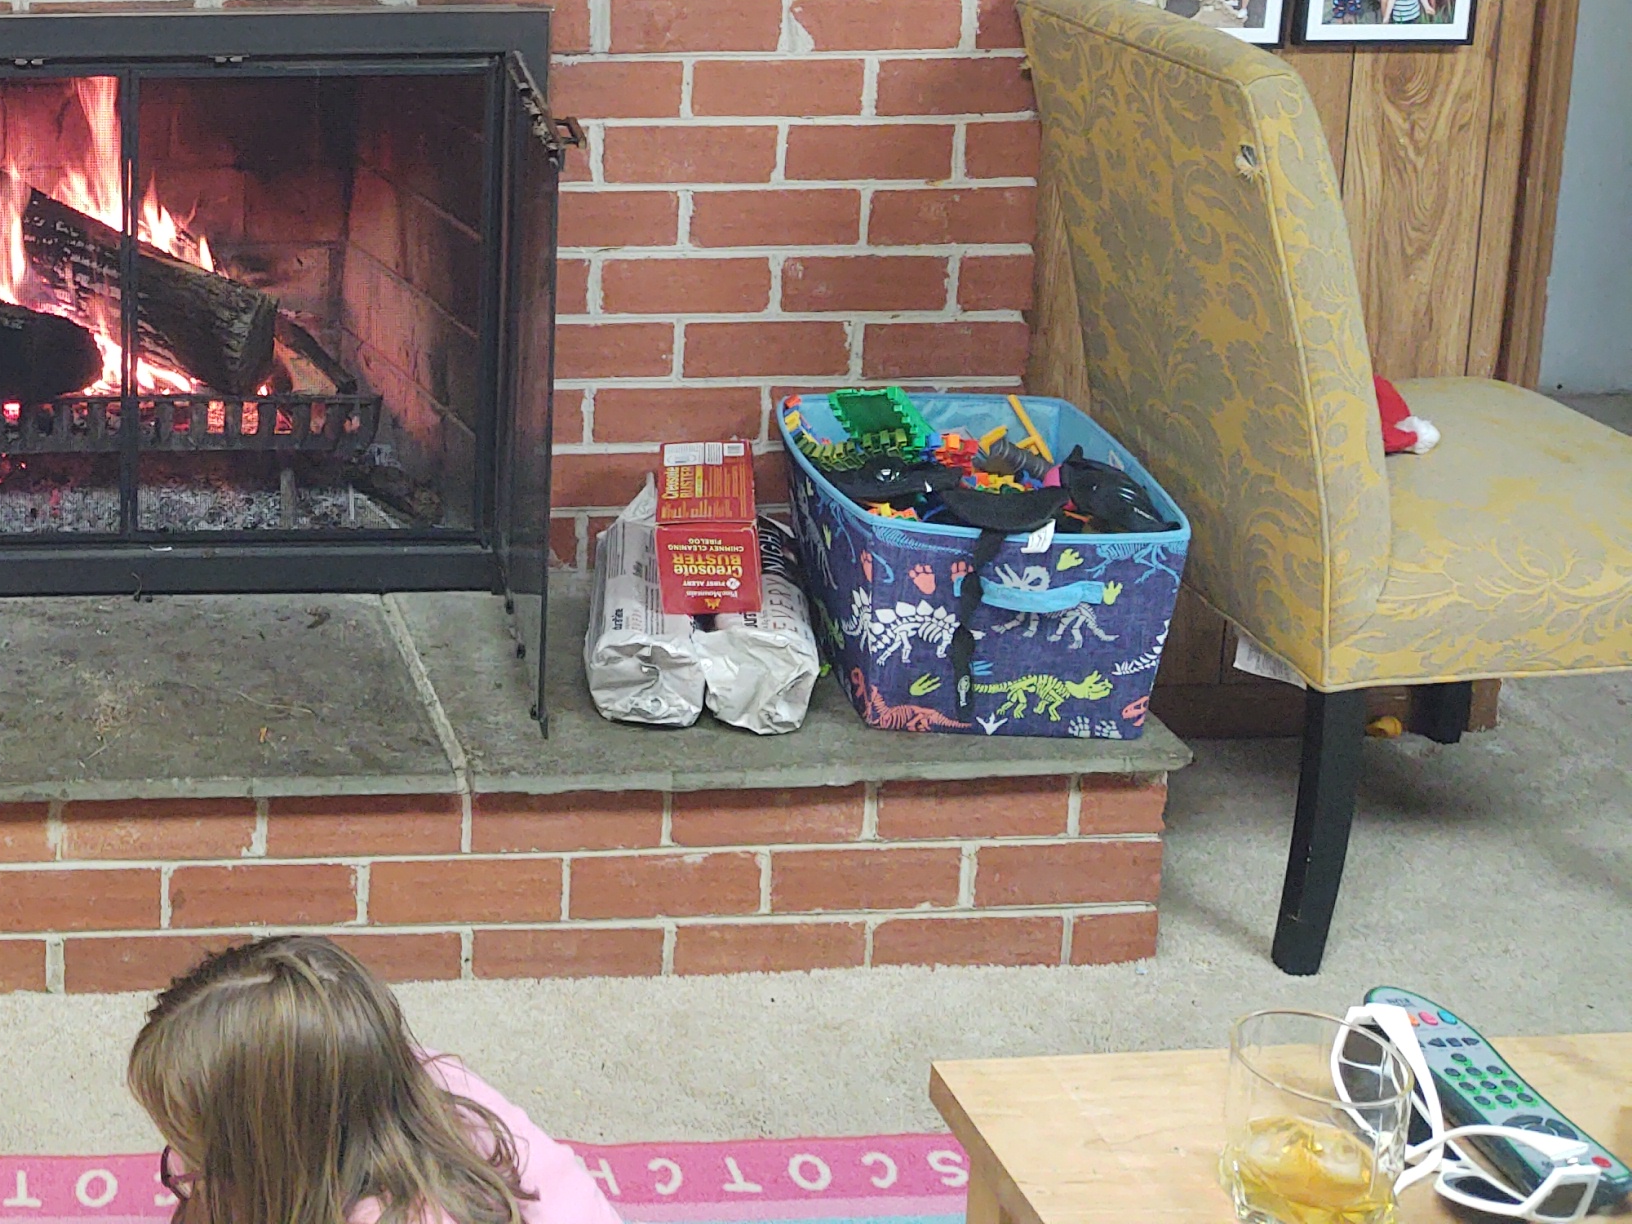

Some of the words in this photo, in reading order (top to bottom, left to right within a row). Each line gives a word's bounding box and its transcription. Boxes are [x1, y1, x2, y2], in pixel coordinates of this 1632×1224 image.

[661, 466, 679, 499] Creosote
[680, 466, 695, 498] BUSTER
[667, 543, 707, 552] CLEANING
[688, 537, 722, 545] FIRELOG
[672, 553, 742, 565] BUSTER
[673, 564, 743, 578] Creosote
